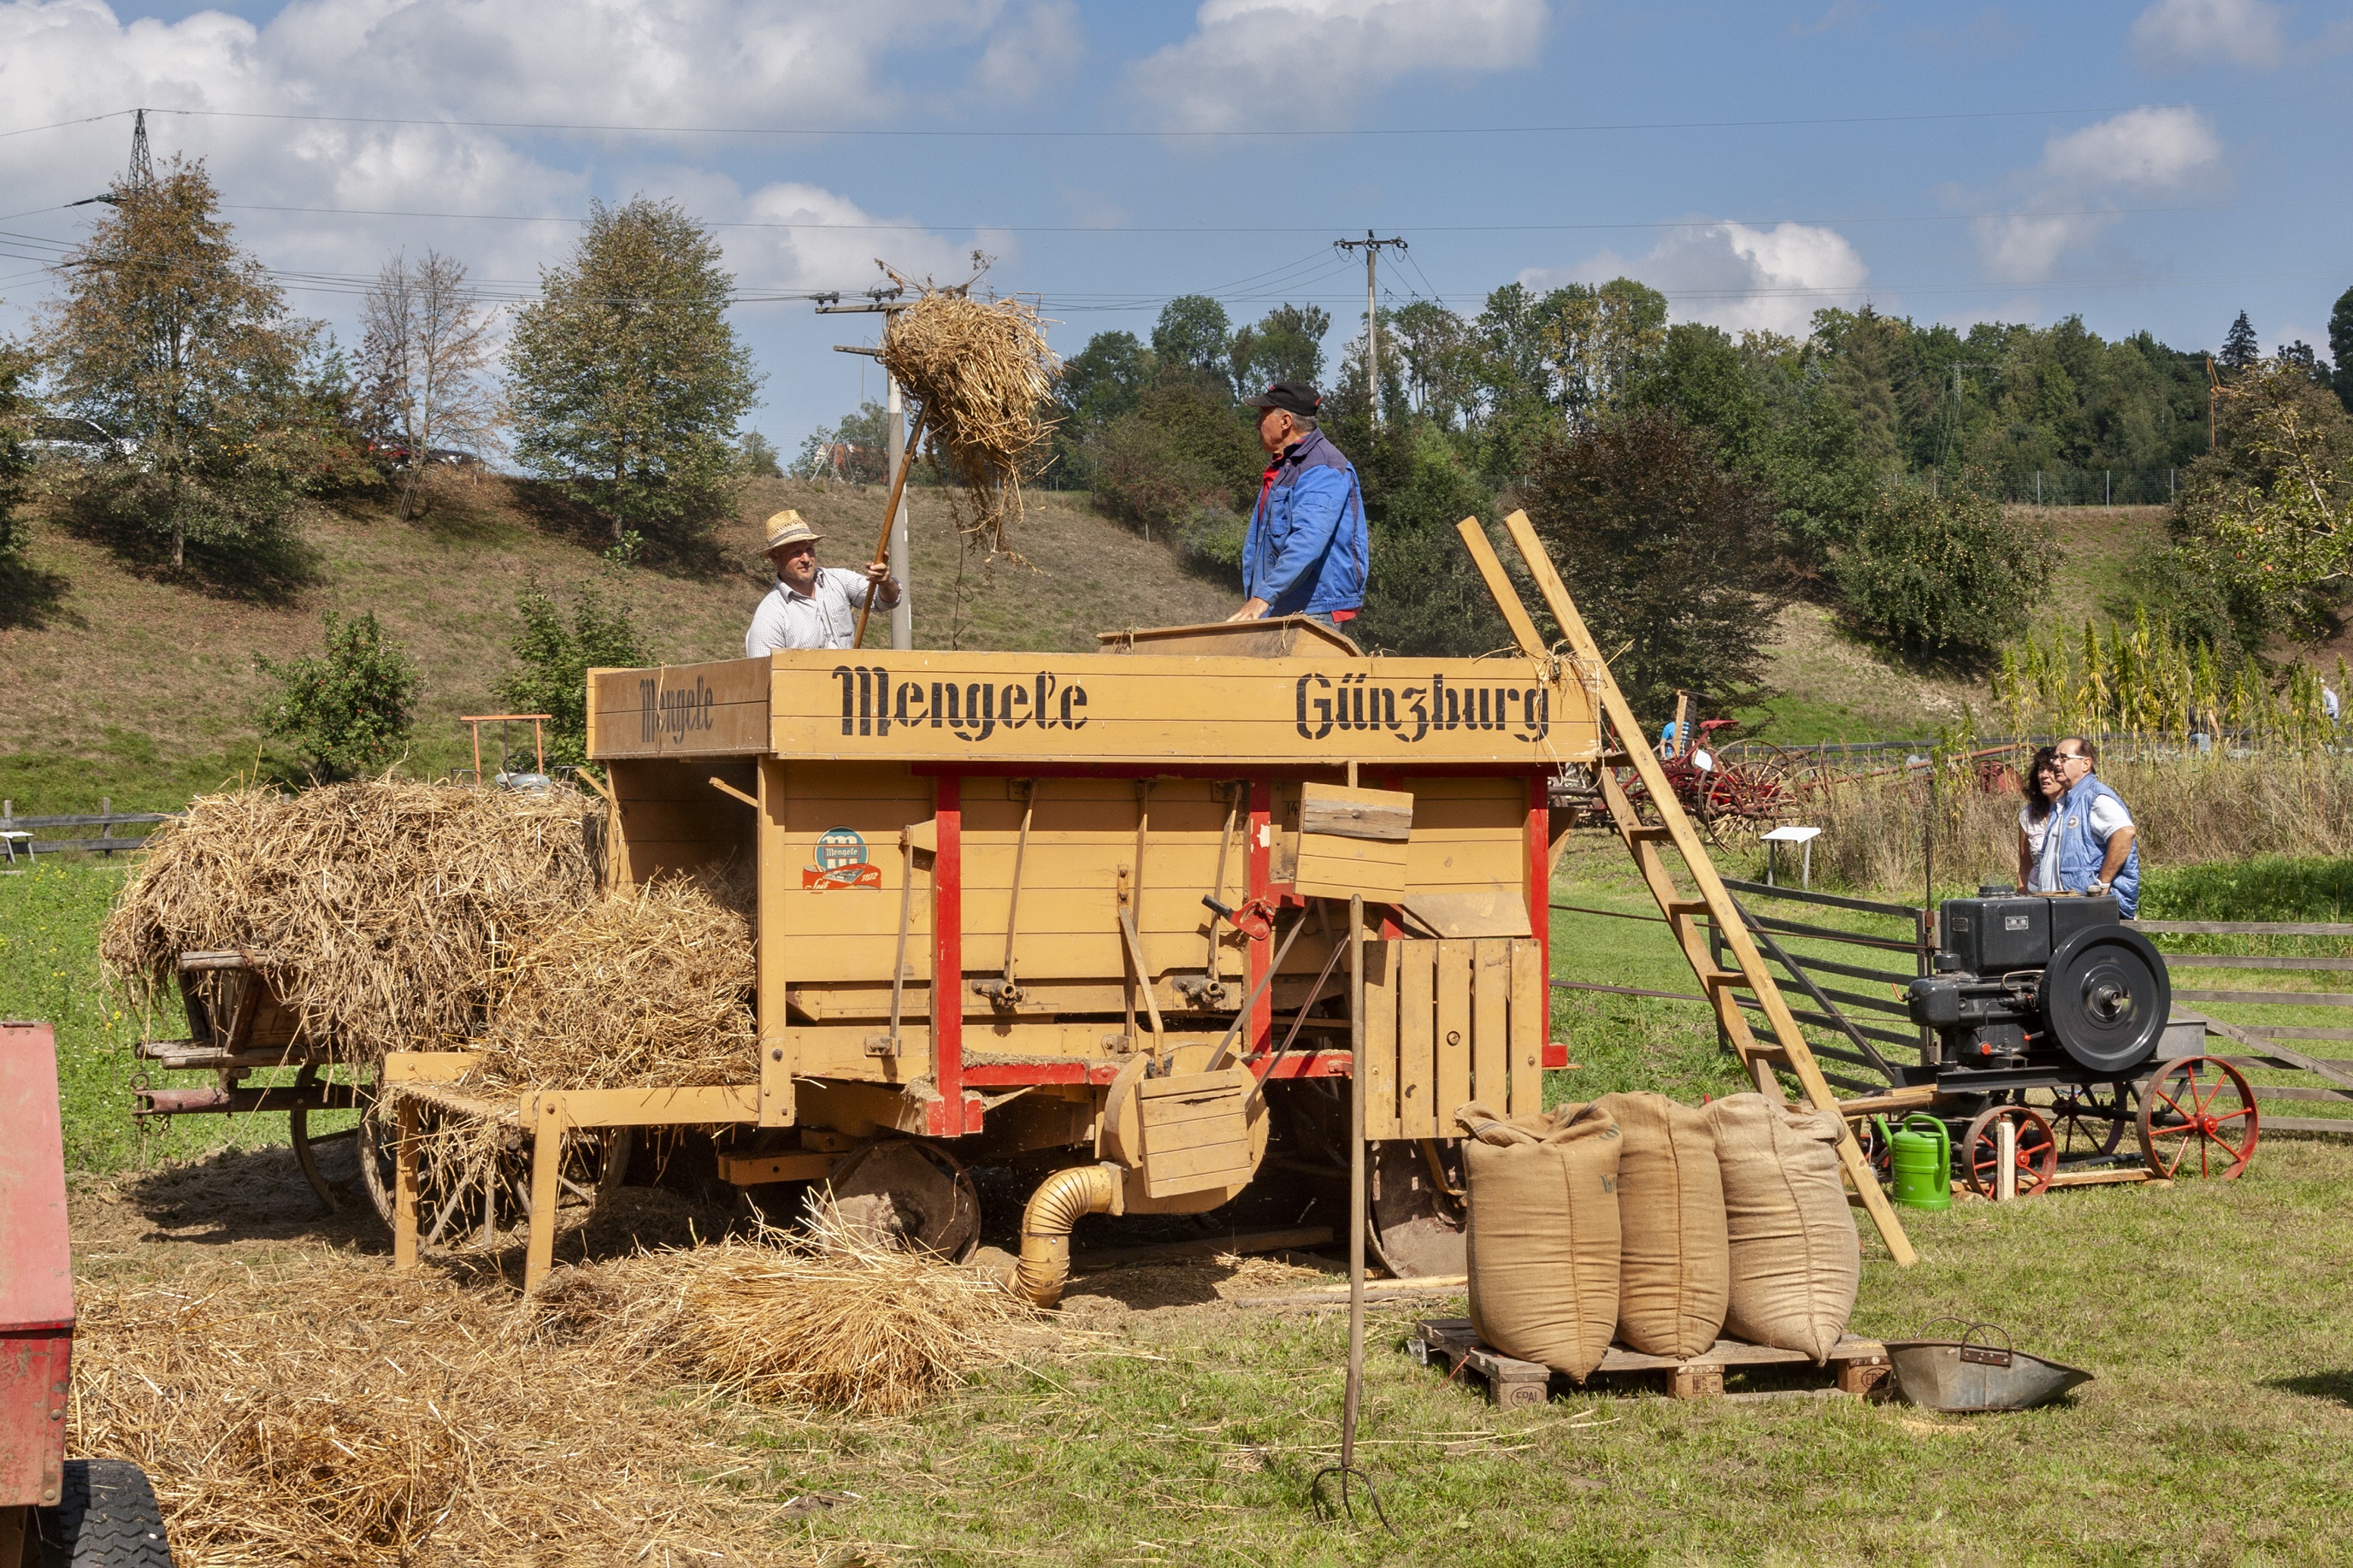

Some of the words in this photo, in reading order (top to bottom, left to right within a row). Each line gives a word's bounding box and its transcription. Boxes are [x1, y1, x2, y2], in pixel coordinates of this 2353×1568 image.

[640, 675, 713, 745] Mengele
[832, 665, 1087, 741] Mengele
[1296, 672, 1548, 742] Günzburg
[826, 847, 858, 857] Mengele
[862, 872, 878, 881] 1872
